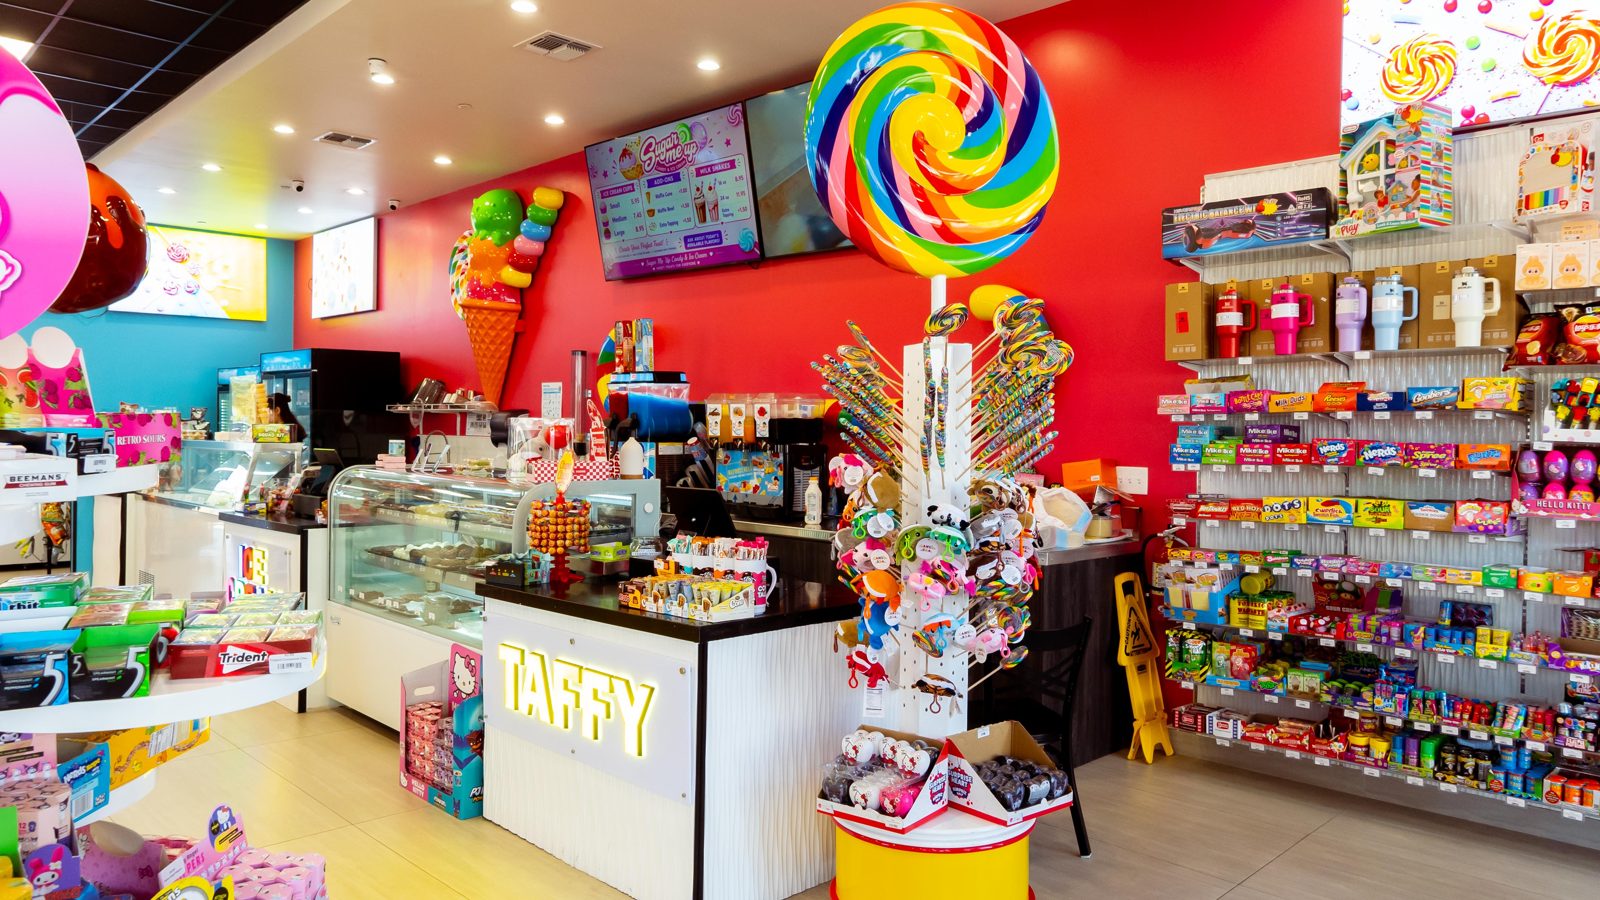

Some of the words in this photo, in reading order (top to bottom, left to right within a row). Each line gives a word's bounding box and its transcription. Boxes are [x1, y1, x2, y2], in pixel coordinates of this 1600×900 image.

[641, 132, 679, 172] Sugar
[666, 145, 683, 164] me
[684, 142, 699, 163] up
[1341, 224, 1358, 235] Play
[1290, 395, 1306, 404] Duds
[1413, 388, 1452, 404] Goobers
[68, 434, 77, 452] 5
[102, 430, 115, 454] 5
[117, 436, 142, 446] RETRO
[143, 434, 166, 444] SOURS
[1412, 451, 1447, 459] Spree
[9, 474, 62, 483] BEEMANS
[1263, 499, 1302, 512] DOTS
[1537, 500, 1564, 509] HELLO
[1567, 502, 1592, 510] KITTY
[238, 544, 268, 584] ICE
[220, 652, 268, 664] Trident
[72, 656, 82, 674] 5
[122, 647, 148, 698] 5
[40, 654, 66, 706] 5
[498, 643, 656, 757] TAFFY
[948, 770, 972, 783] SURPRISE
[951, 777, 968, 787] HEART
[412, 779, 425, 790] HELLO
[412, 786, 424, 798] KITTY
[470, 786, 481, 798] PJ
